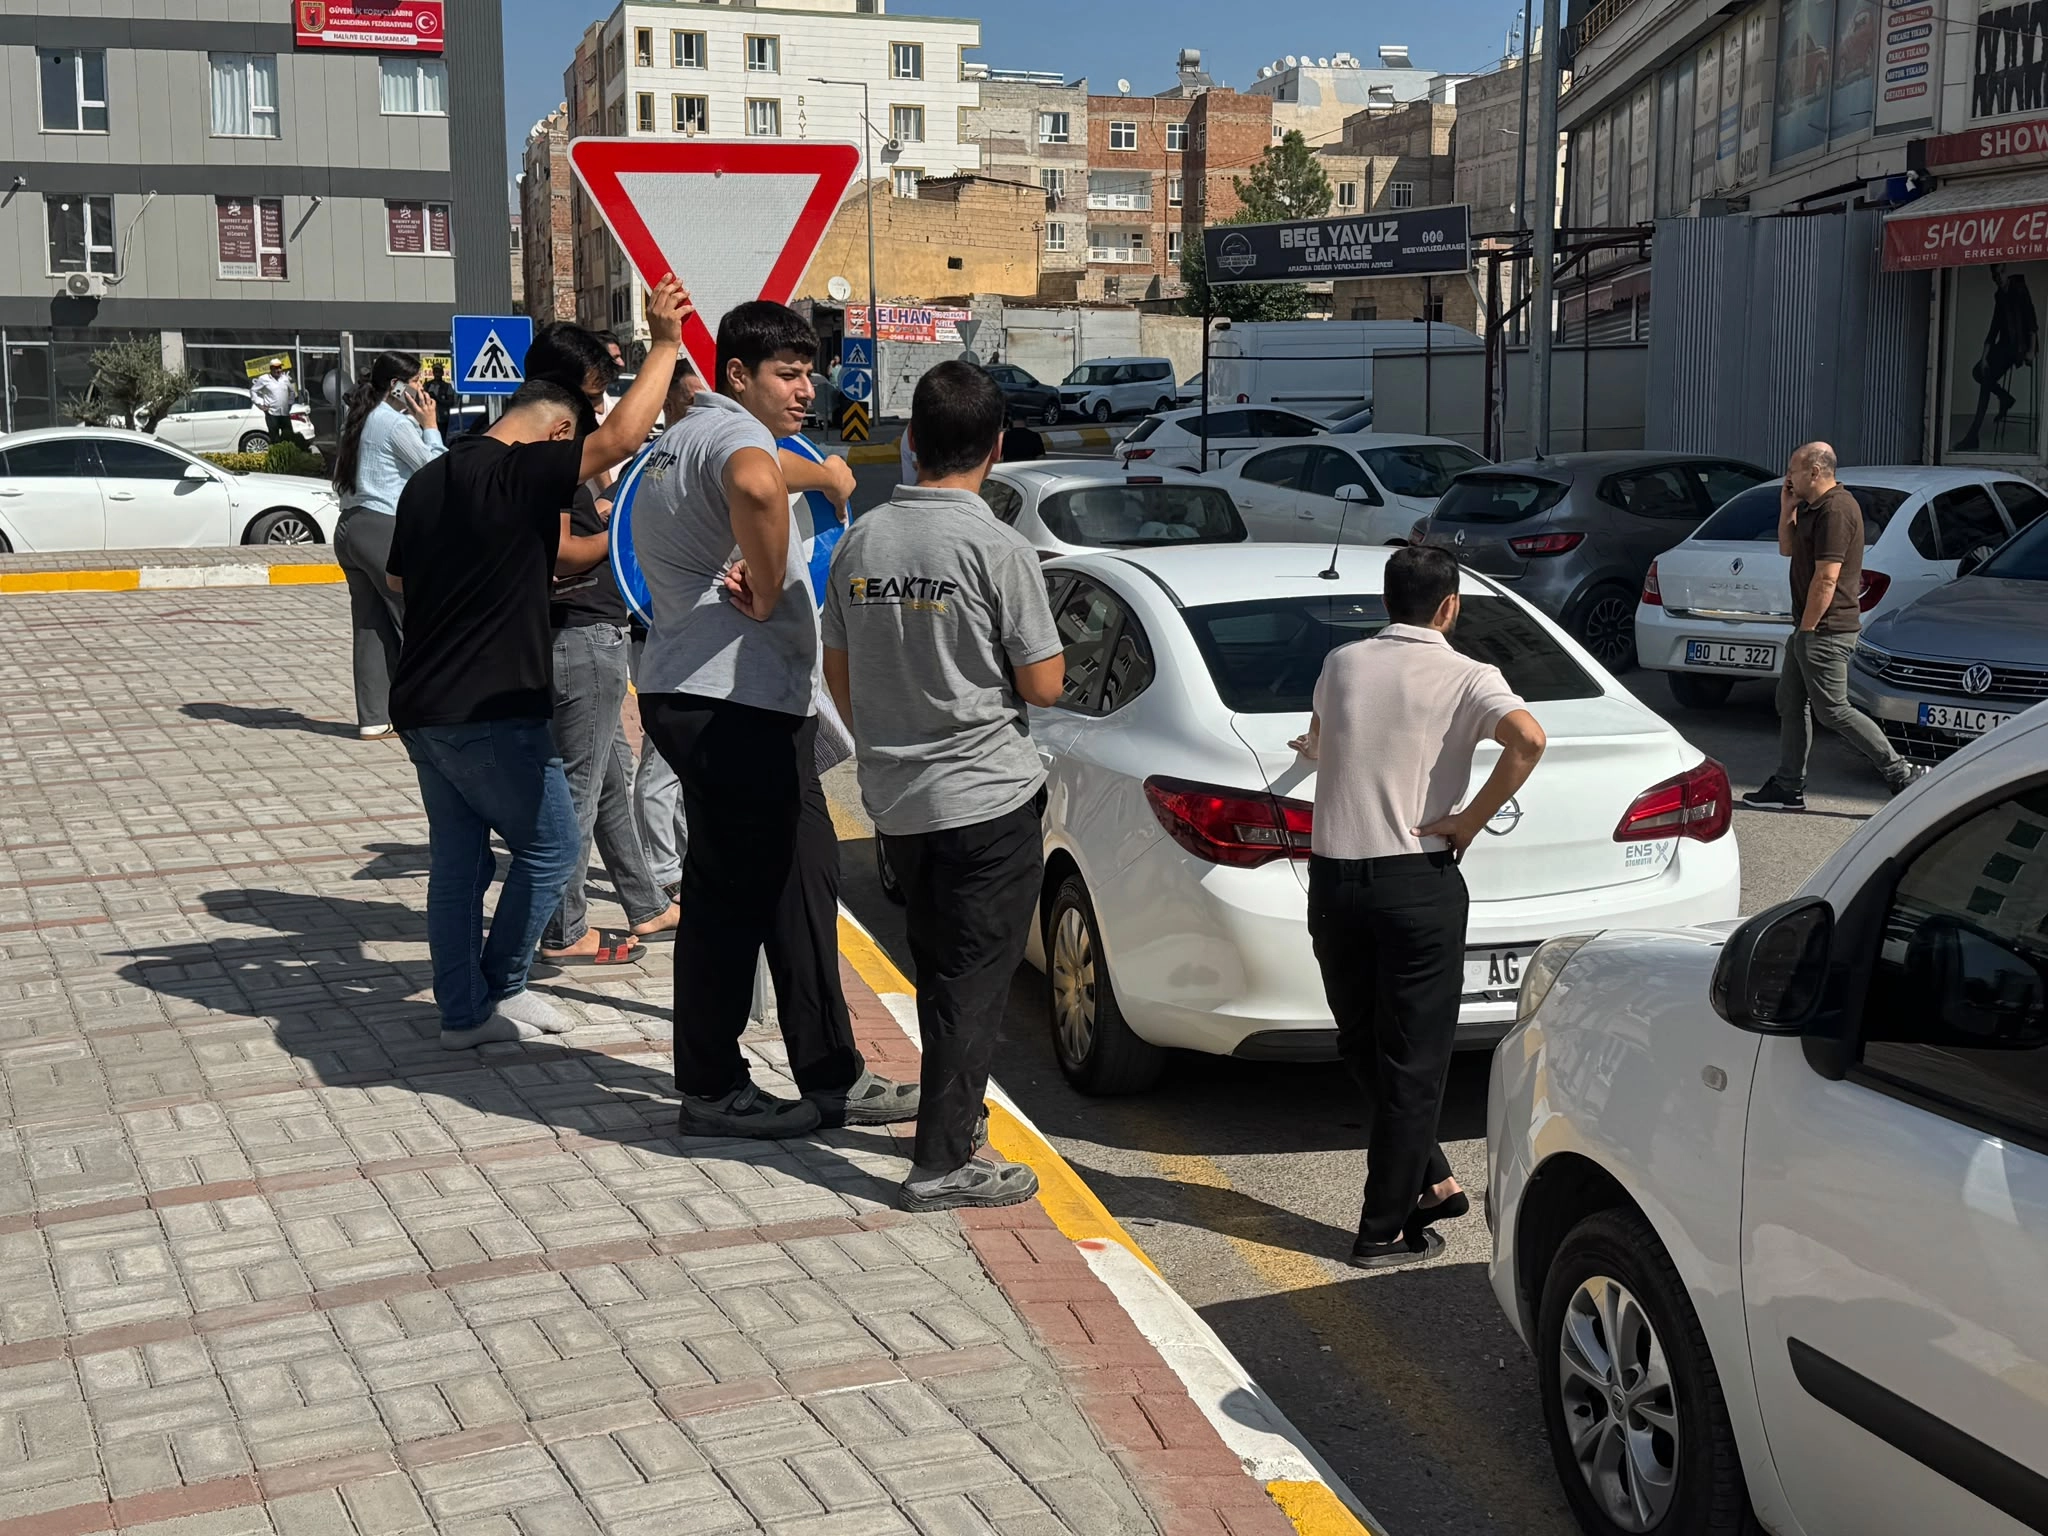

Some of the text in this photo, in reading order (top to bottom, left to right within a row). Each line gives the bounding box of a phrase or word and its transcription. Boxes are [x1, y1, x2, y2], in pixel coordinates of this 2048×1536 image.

[1279, 221, 1399, 249] BEG YAVUZ
[1924, 211, 2048, 249] SHOW CE
[1305, 244, 1373, 262] GARAGE
[1964, 243, 2043, 259] ERKEK GİYİM
[867, 308, 932, 325] ELHAN
[1695, 644, 1711, 660] 80
[1719, 645, 1736, 662] LC
[1744, 647, 1770, 665] 322
[1926, 707, 1948, 726] 63
[1953, 710, 1986, 730] ALC
[1625, 842, 1653, 859] ENS
[1487, 951, 1520, 986] AG
